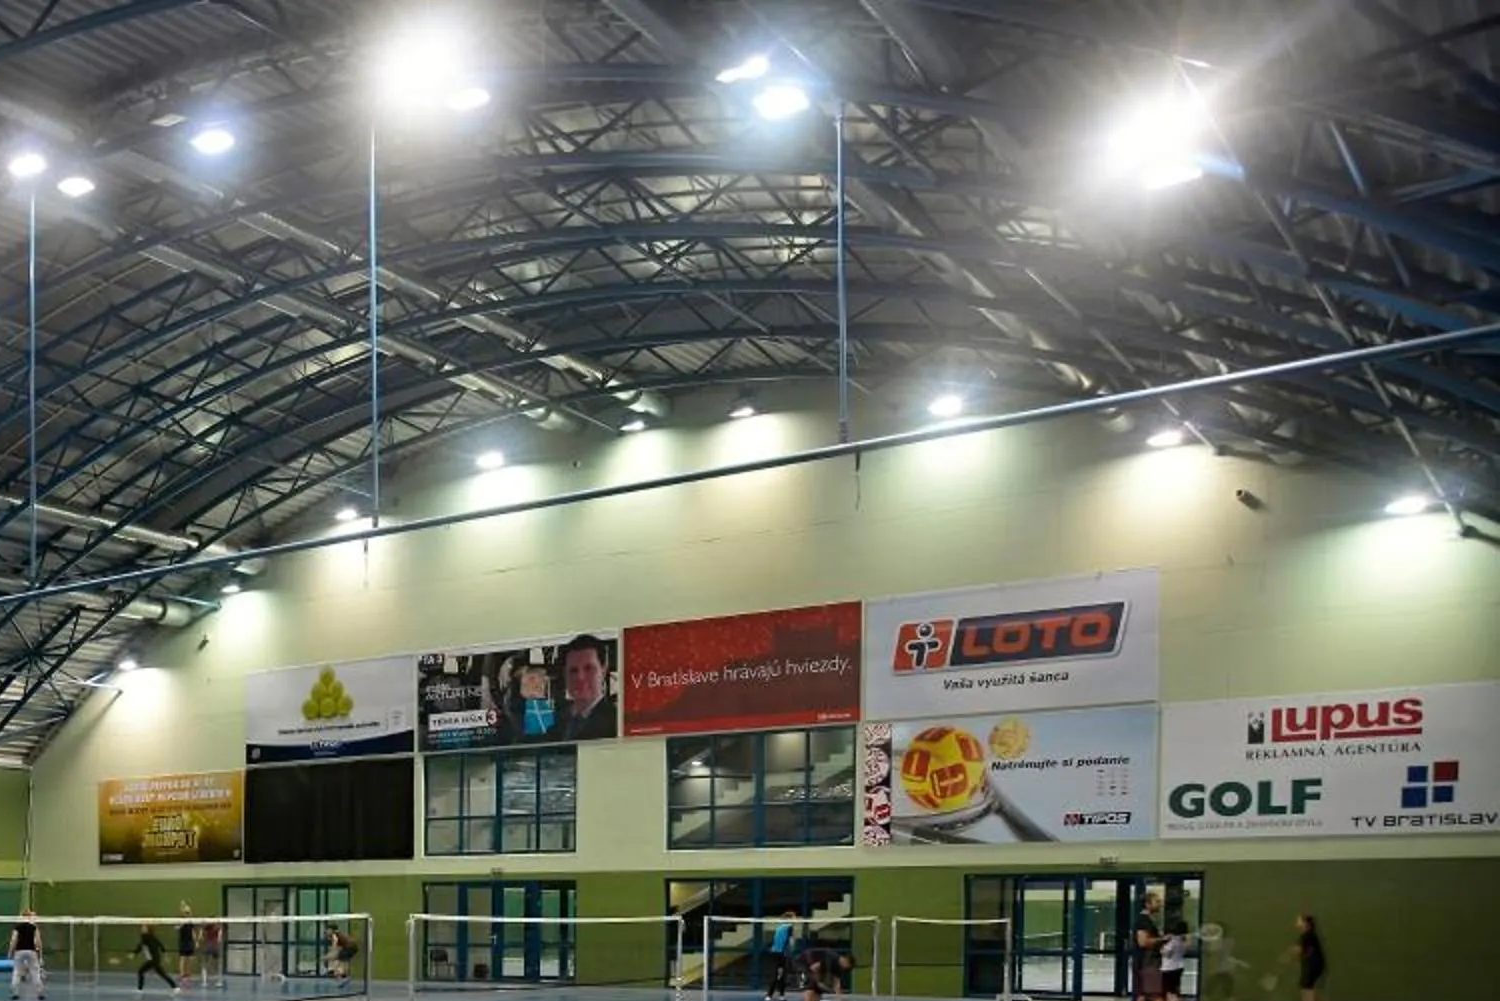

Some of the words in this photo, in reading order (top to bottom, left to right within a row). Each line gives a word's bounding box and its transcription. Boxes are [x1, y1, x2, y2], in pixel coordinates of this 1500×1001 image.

[961, 611, 1111, 657] LOTO
[631, 674, 643, 689] V
[647, 671, 719, 688] Bratislave
[723, 660, 782, 682] hrávajú
[785, 655, 852, 676] hviezdy.
[943, 675, 973, 690] Vaša
[977, 671, 1025, 689] využitá
[1029, 670, 1069, 684] šanca
[1271, 698, 1423, 742] Lupus
[1062, 757, 1073, 767] si
[1076, 755, 1130, 768] podanie
[1245, 745, 1326, 761] REKLAMNÁ
[1168, 778, 1323, 818] GOLF
[1082, 812, 1129, 824] TIPOS
[1351, 815, 1377, 828] TV
